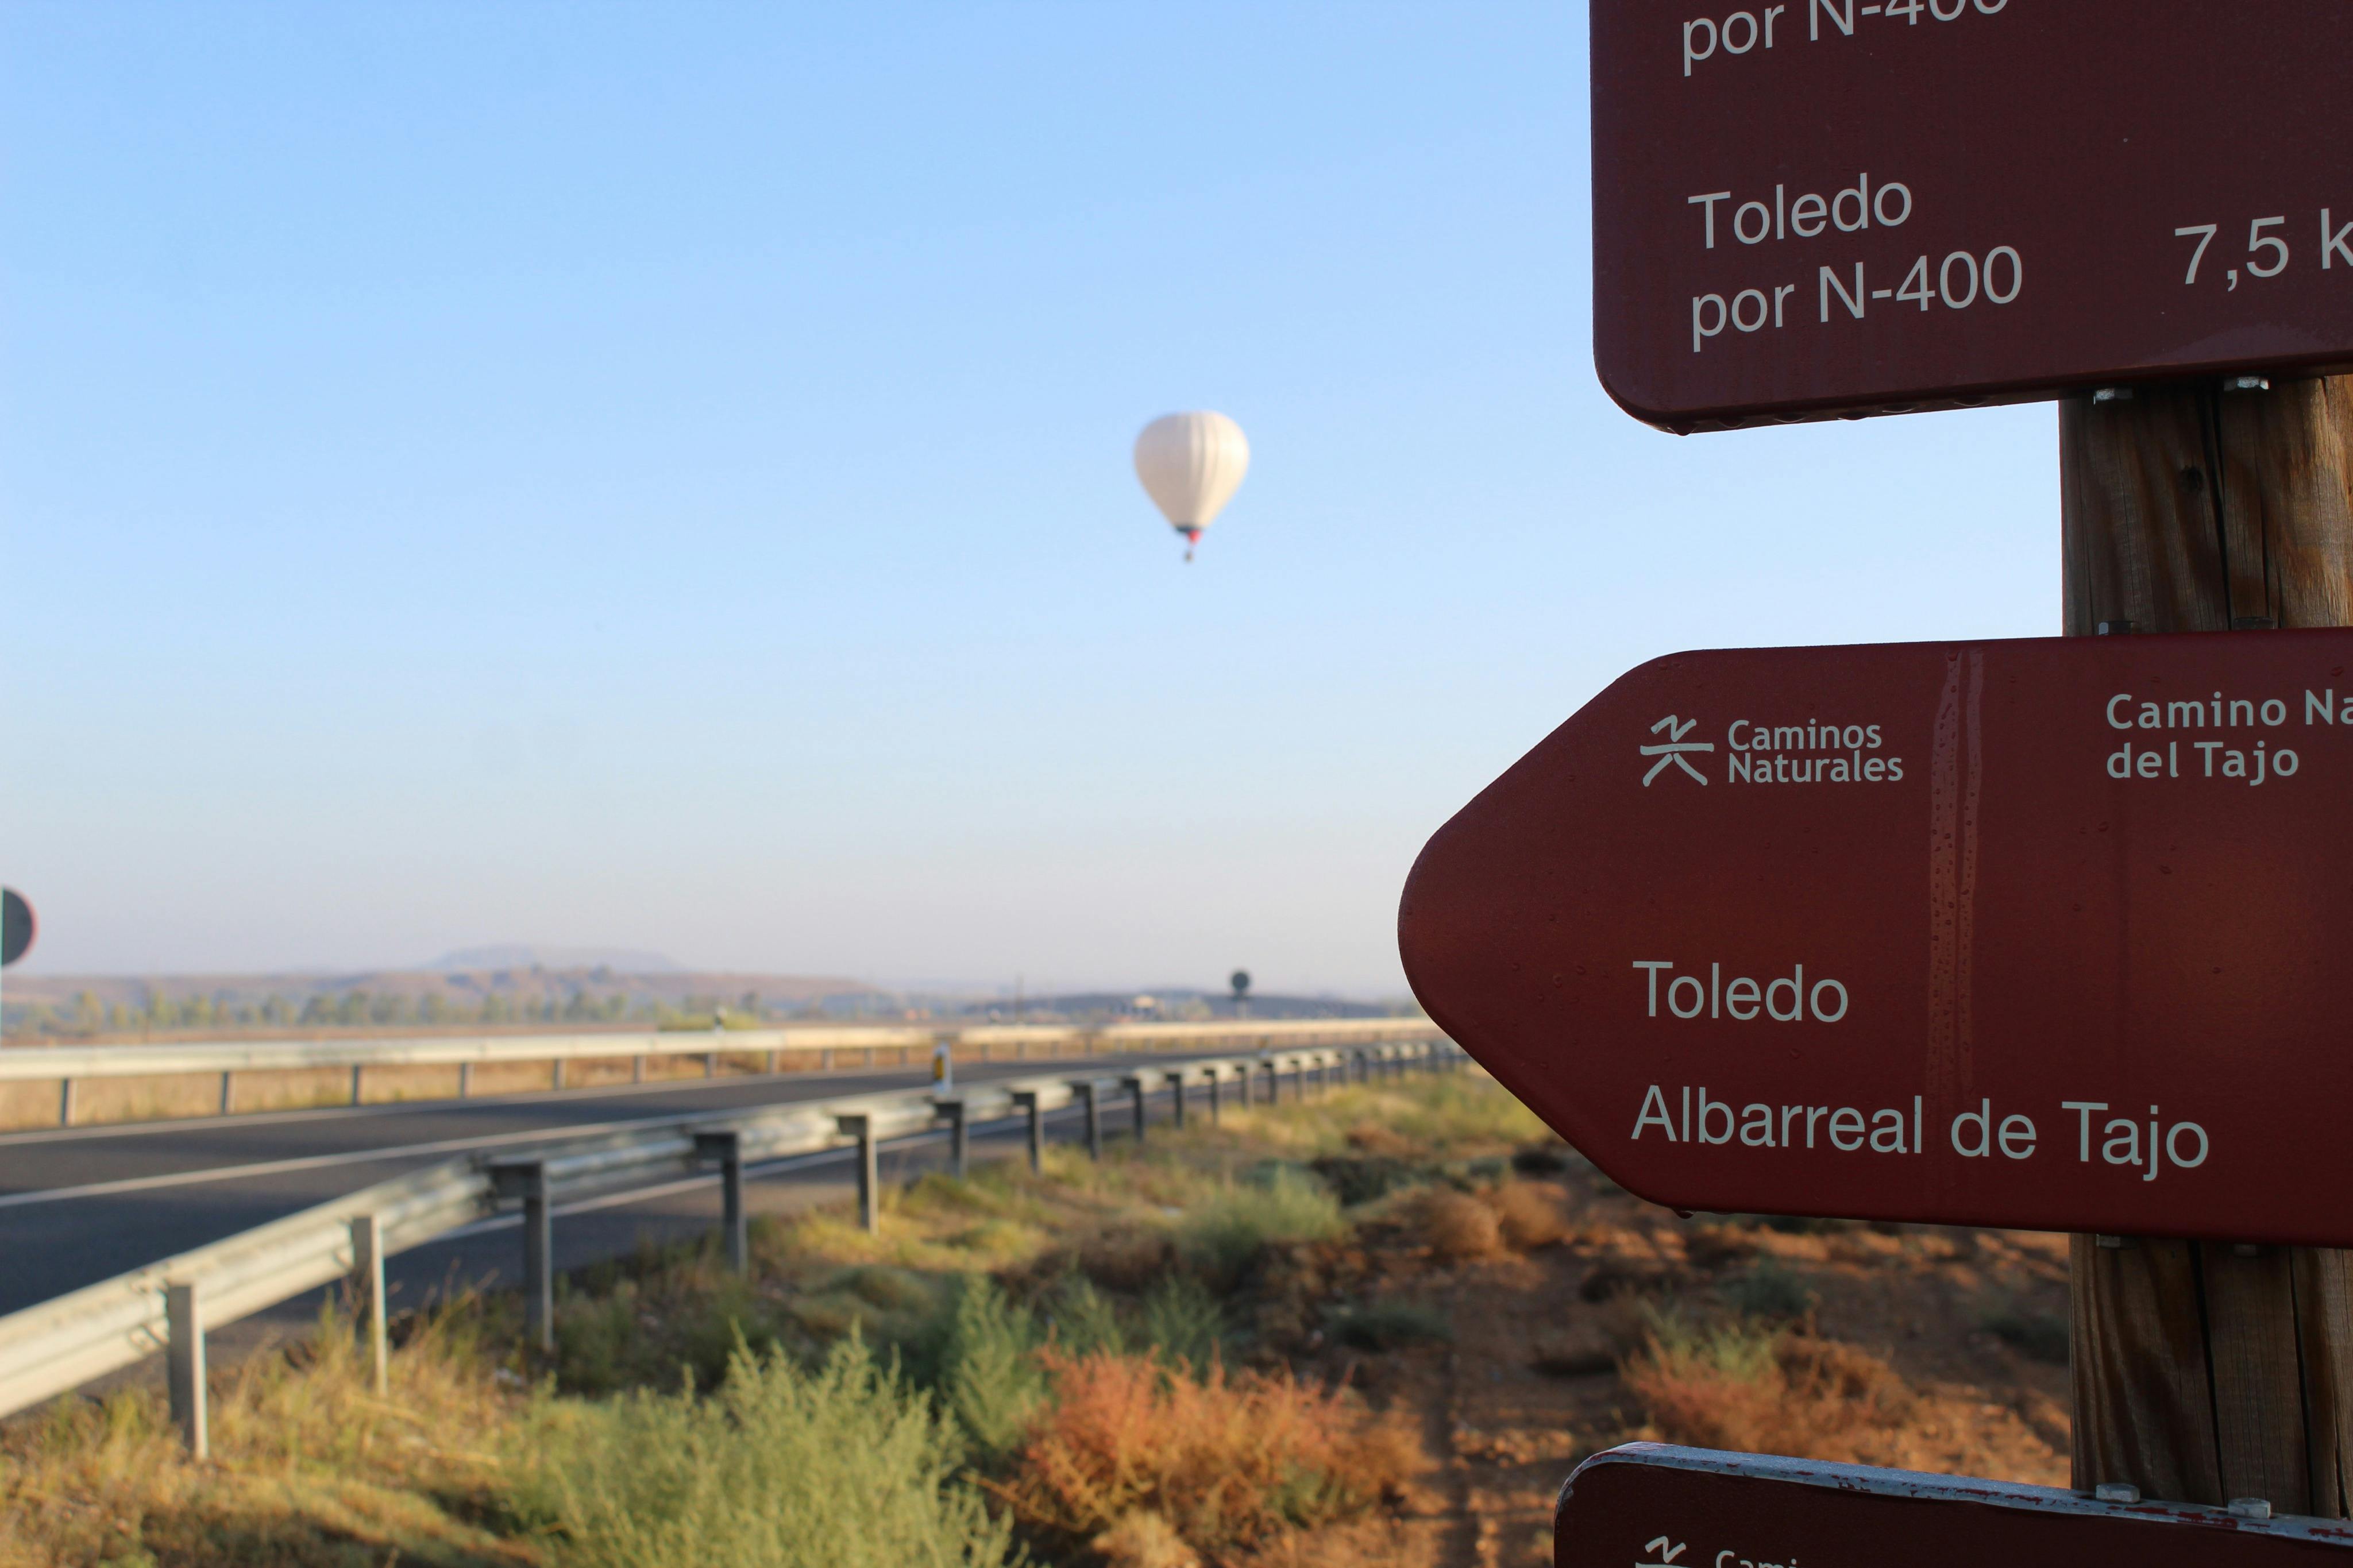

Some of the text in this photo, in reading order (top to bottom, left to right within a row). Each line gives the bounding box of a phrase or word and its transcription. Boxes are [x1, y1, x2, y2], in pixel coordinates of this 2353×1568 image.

[1683, 5, 1784, 77] por
[1688, 172, 1912, 249] Toledo
[2175, 215, 2289, 292] 7,5
[1692, 245, 2022, 353] por N-400
[1728, 718, 1882, 751] Caminos
[2107, 691, 2286, 729] Camino
[1729, 750, 1903, 783] Naturales
[2107, 740, 2298, 786] del Tajo
[1632, 961, 1848, 1022] Toledo
[1631, 1084, 2209, 1181] Albarreal de Tajo
